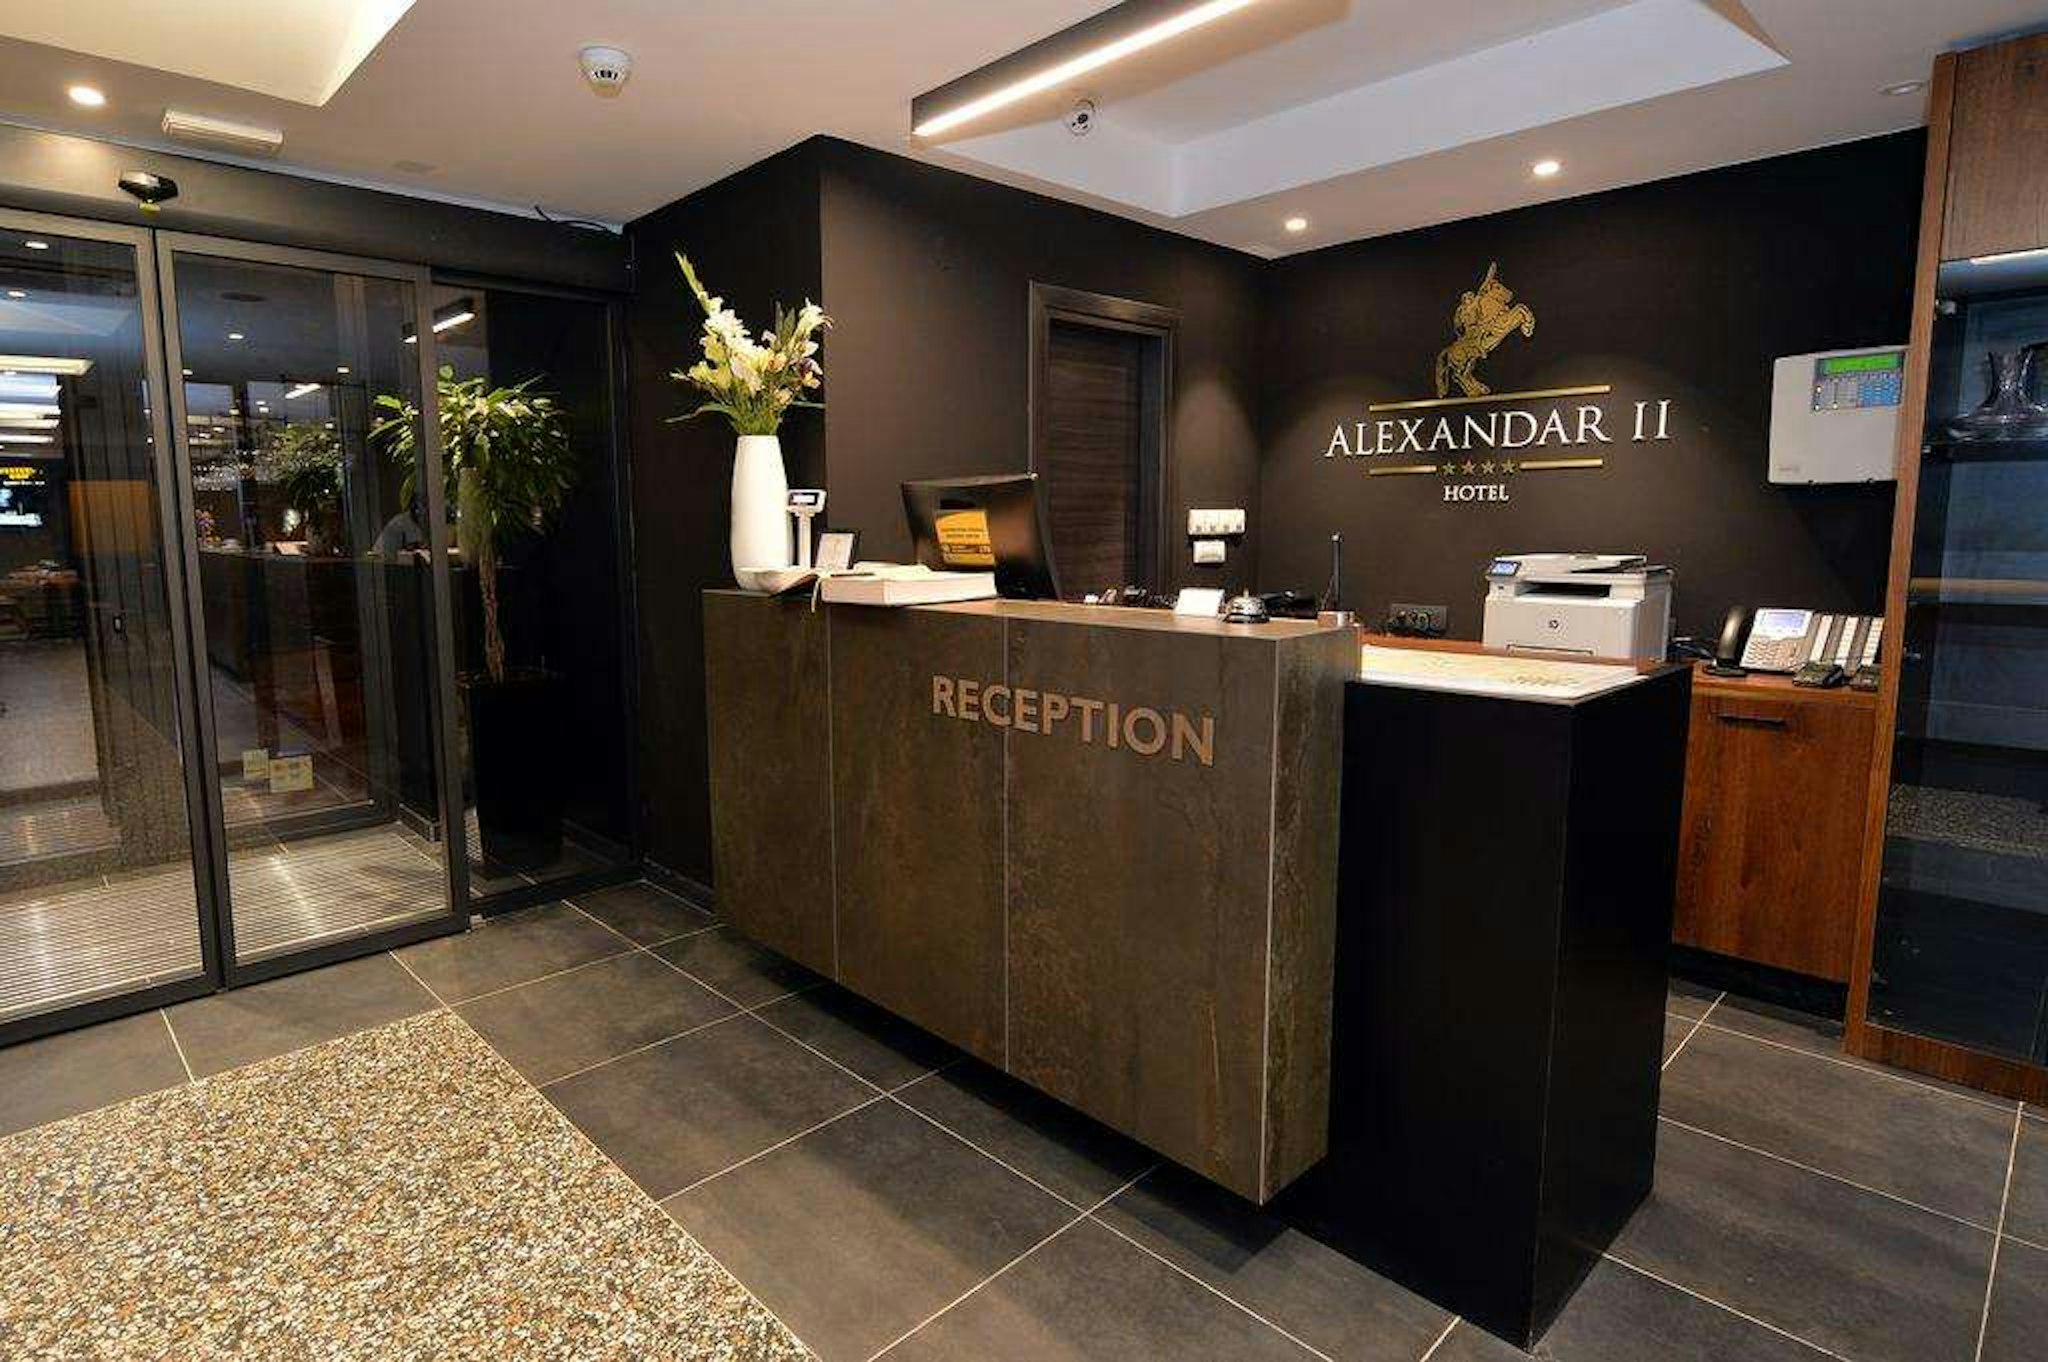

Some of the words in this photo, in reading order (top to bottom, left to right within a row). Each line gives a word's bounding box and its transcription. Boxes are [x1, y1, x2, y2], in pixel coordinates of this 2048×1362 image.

[1324, 404, 1612, 457] ALEXANDAR
[1631, 400, 1672, 441] II
[1443, 484, 1510, 501] HOTEL
[932, 674, 1215, 767] RECEPTION
